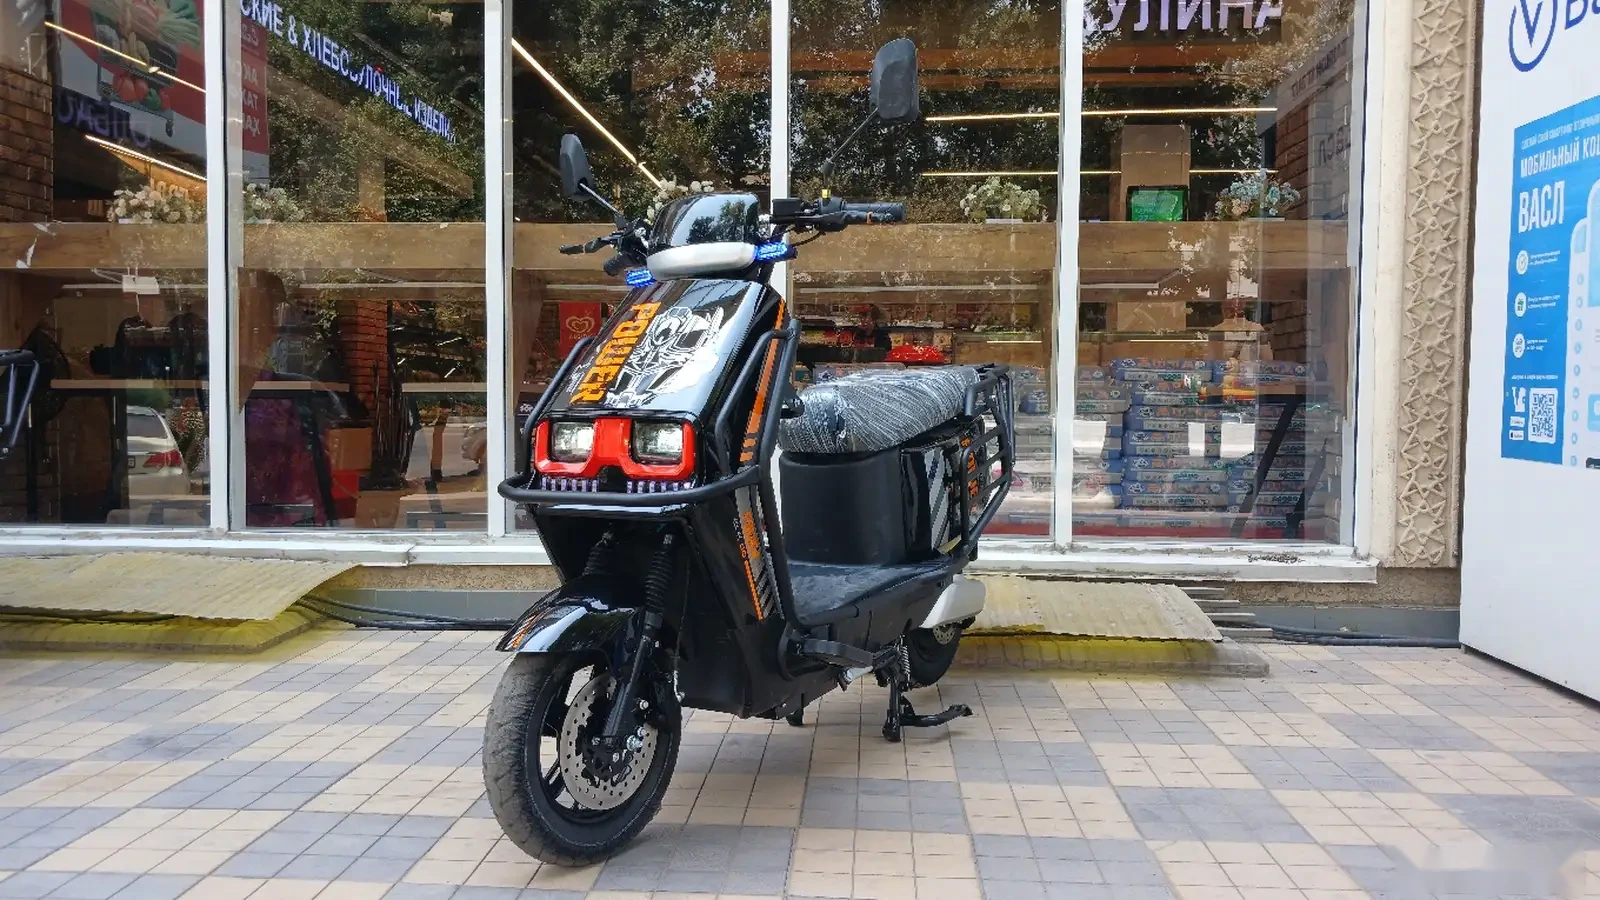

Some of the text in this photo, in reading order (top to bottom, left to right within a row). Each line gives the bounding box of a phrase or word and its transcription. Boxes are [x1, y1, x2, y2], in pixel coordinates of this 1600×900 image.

[414, 97, 456, 145] ИЗДЕЛИ
[1520, 136, 1580, 178] МОБИЛЬНЫЙ
[1518, 180, 1565, 234] ВАСЛ
[569, 302, 661, 405] POWER
